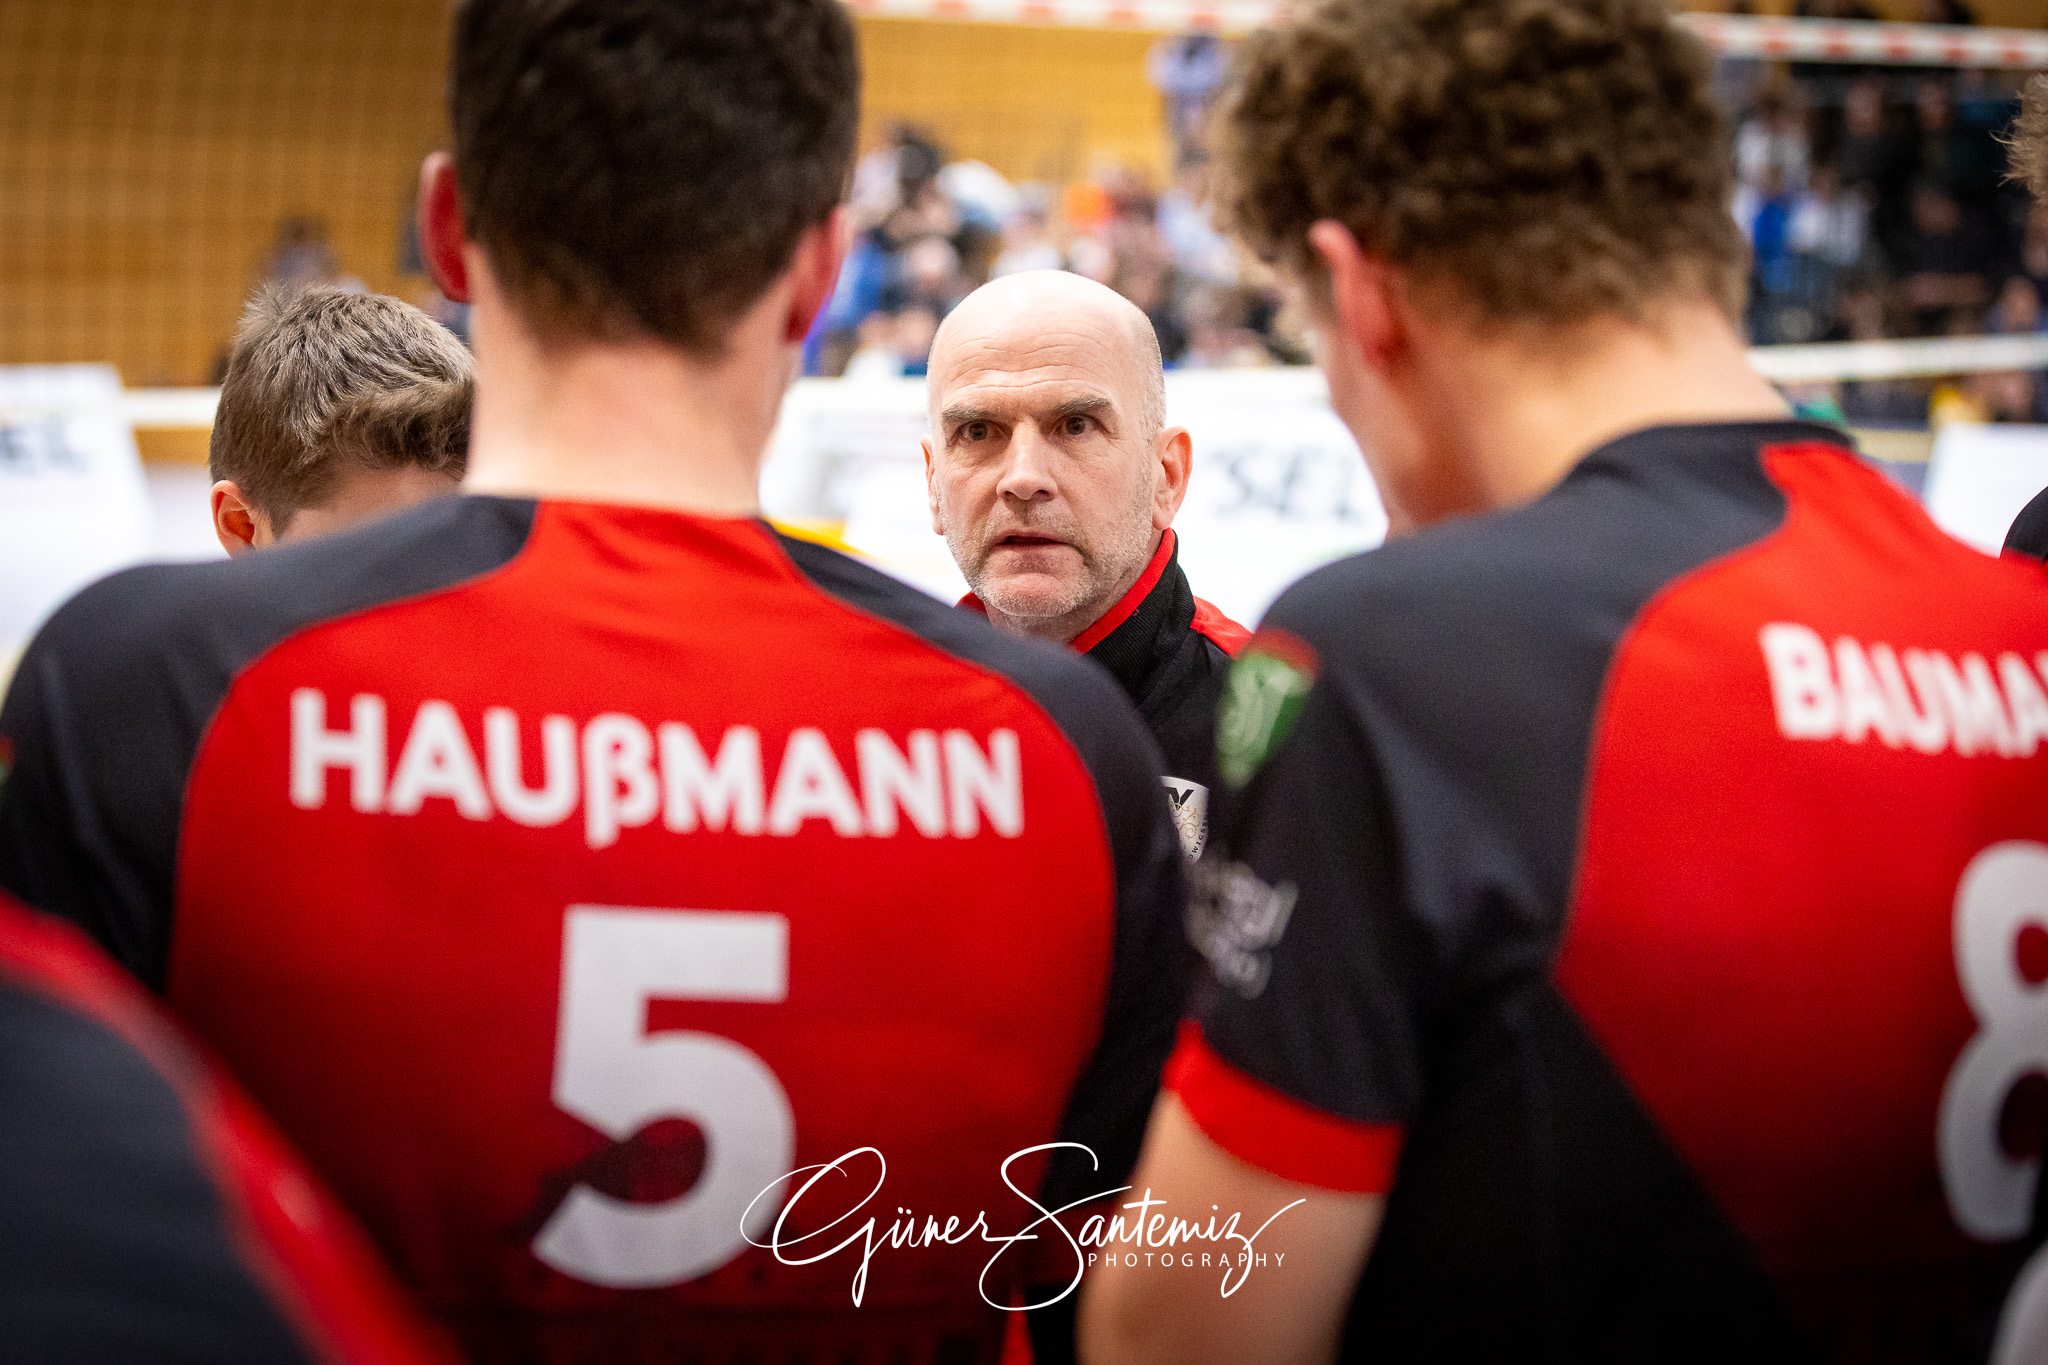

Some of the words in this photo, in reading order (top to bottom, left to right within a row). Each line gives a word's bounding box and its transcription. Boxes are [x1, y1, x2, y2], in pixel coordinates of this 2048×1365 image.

[288, 688, 1024, 849] HAUßMANN
[1758, 620, 2048, 759] BAUMA
[533, 903, 795, 1290] 5
[1937, 840, 2048, 1240] 8
